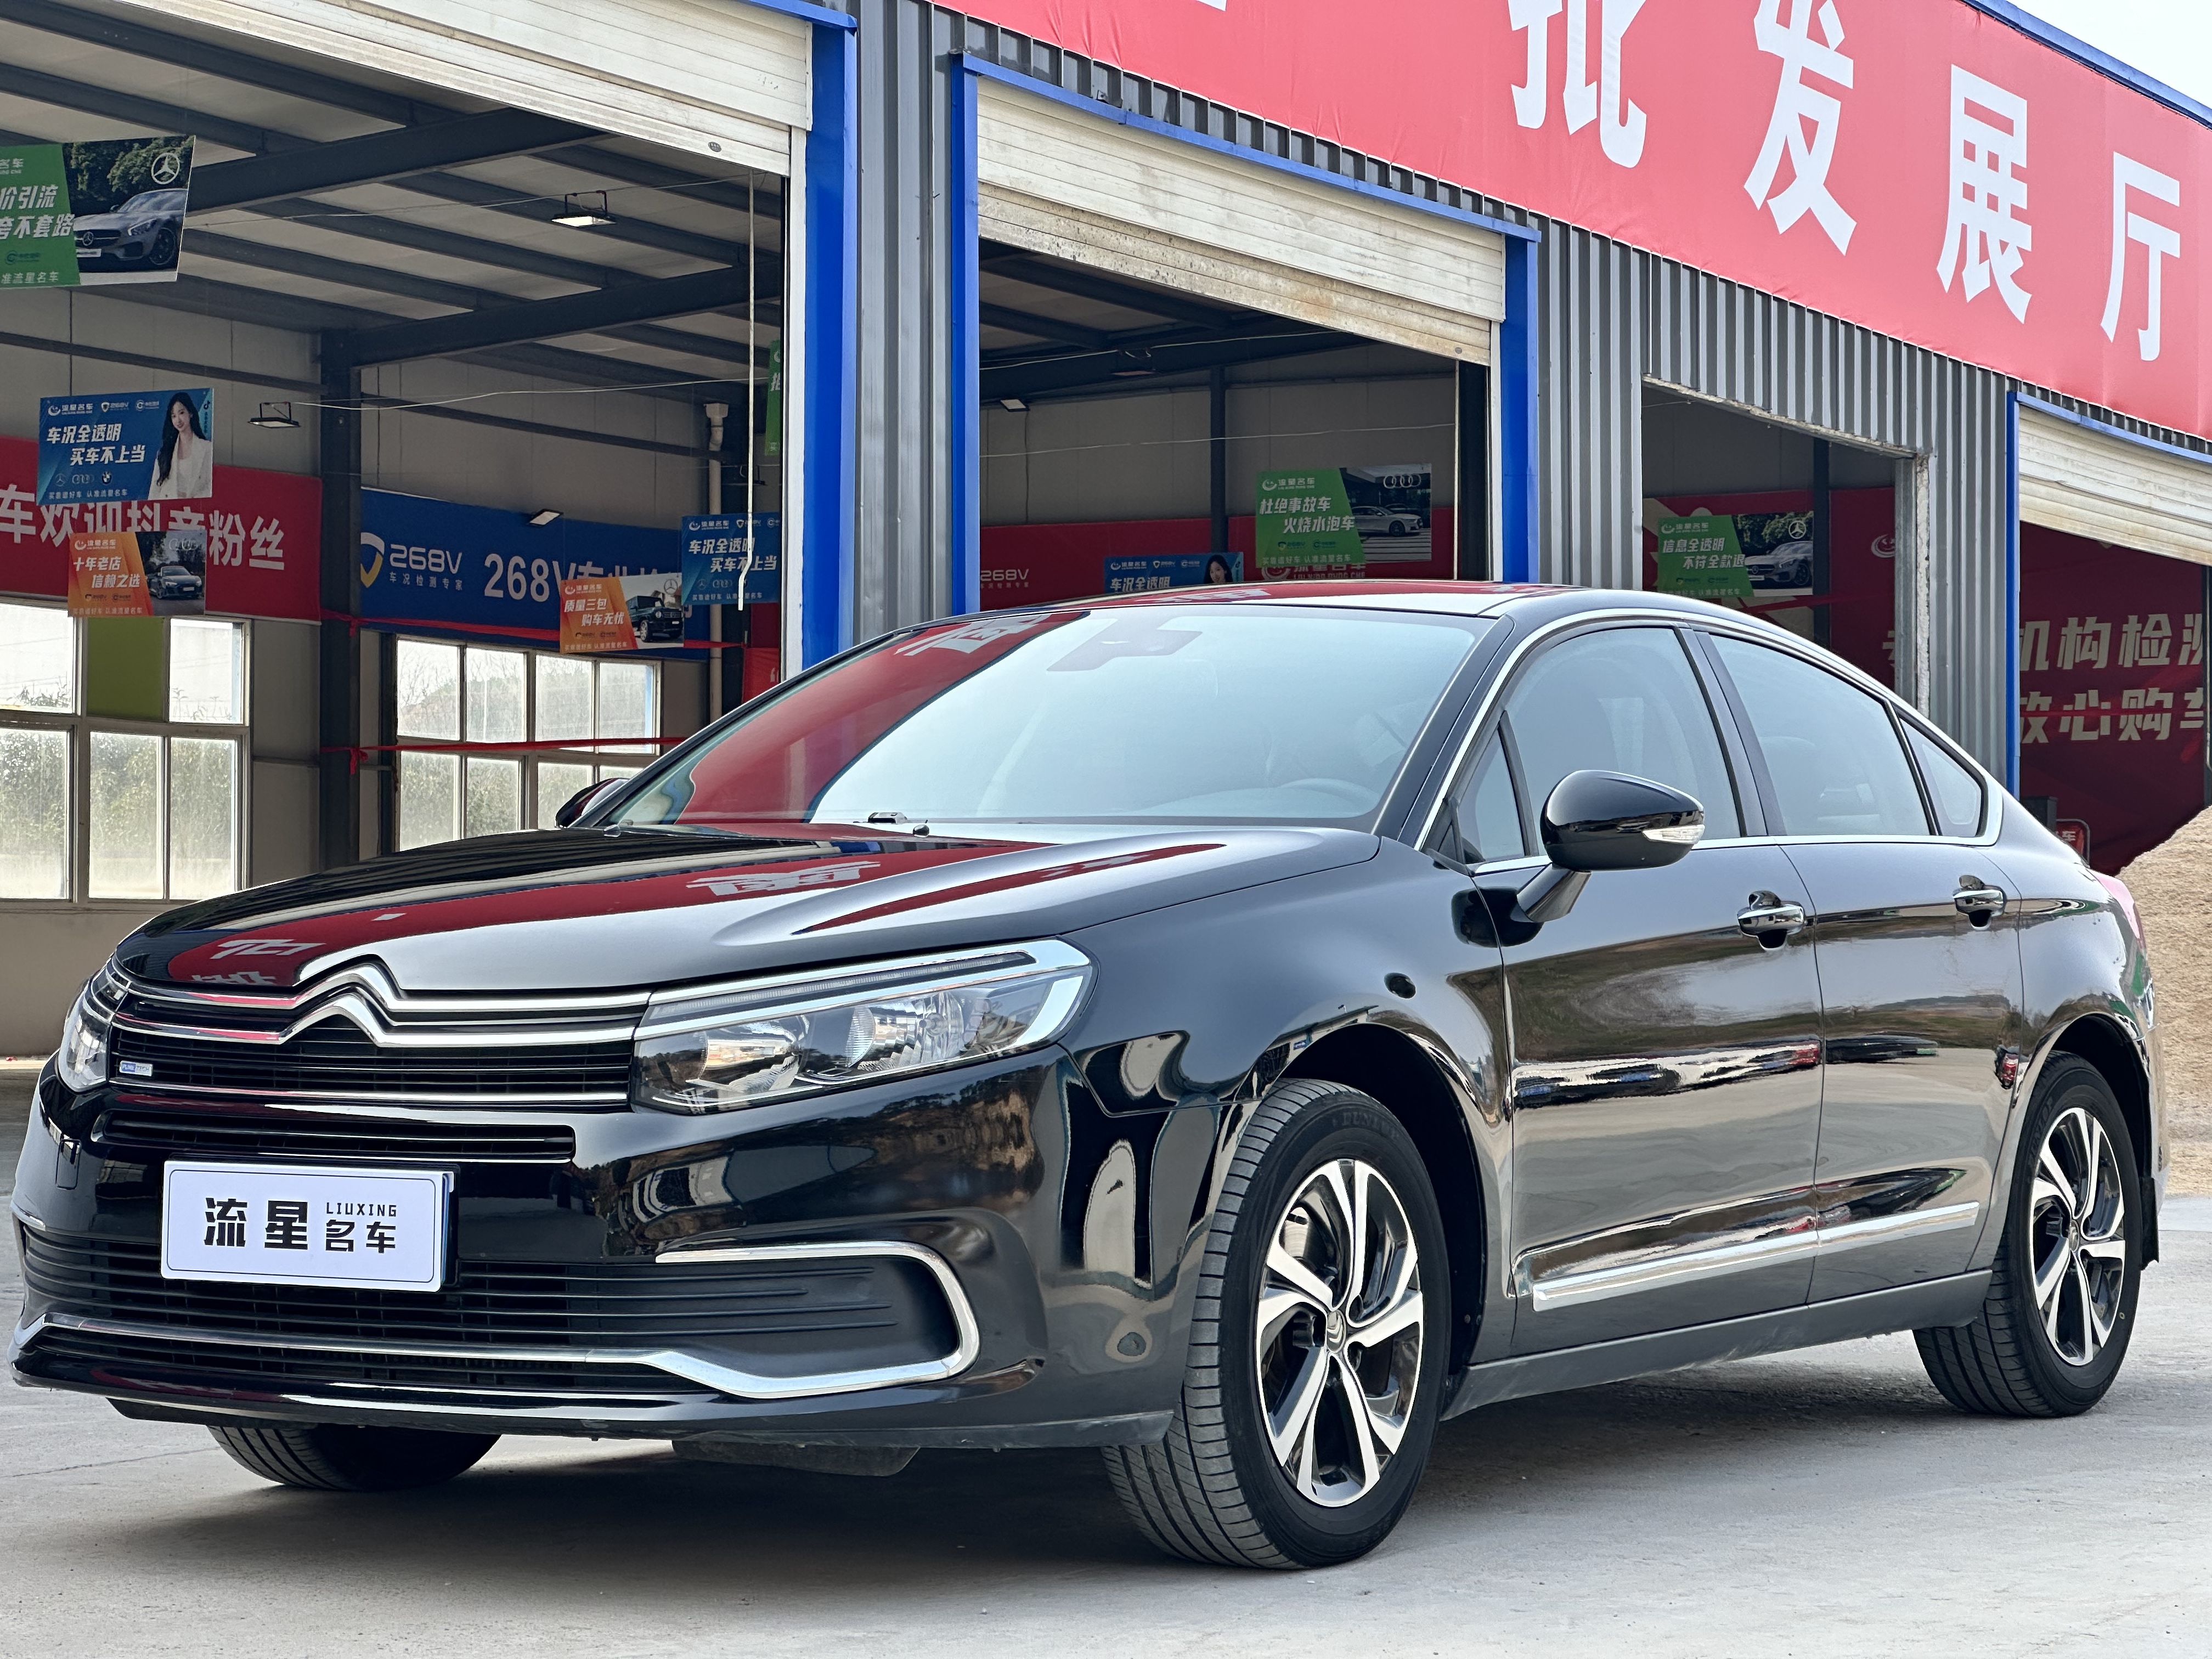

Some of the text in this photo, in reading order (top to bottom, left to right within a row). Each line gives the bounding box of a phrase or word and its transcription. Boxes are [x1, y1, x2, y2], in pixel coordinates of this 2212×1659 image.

[47, 423, 122, 444] 车况全透明
[70, 444, 145, 466] 买车不上当
[1260, 496, 1331, 515] 杜绝事故车
[1283, 515, 1355, 534] 火烧水泡车
[1662, 537, 1725, 554] 信息全透明
[73, 556, 122, 572] 十年老店
[390, 544, 462, 574] 268V
[1683, 554, 1745, 569] 不符全款退
[92, 573, 140, 588] 信赖之选
[390, 571, 462, 591] 车况检测专家
[980, 568, 1029, 582] 268V
[1110, 576, 1171, 592] 车况全透明
[564, 598, 607, 613] 质量三包
[582, 611, 625, 627] 购车无忧
[326, 1202, 397, 1217] LIUXING
[204, 1198, 308, 1250] 流星
[325, 1219, 397, 1254] 名车
